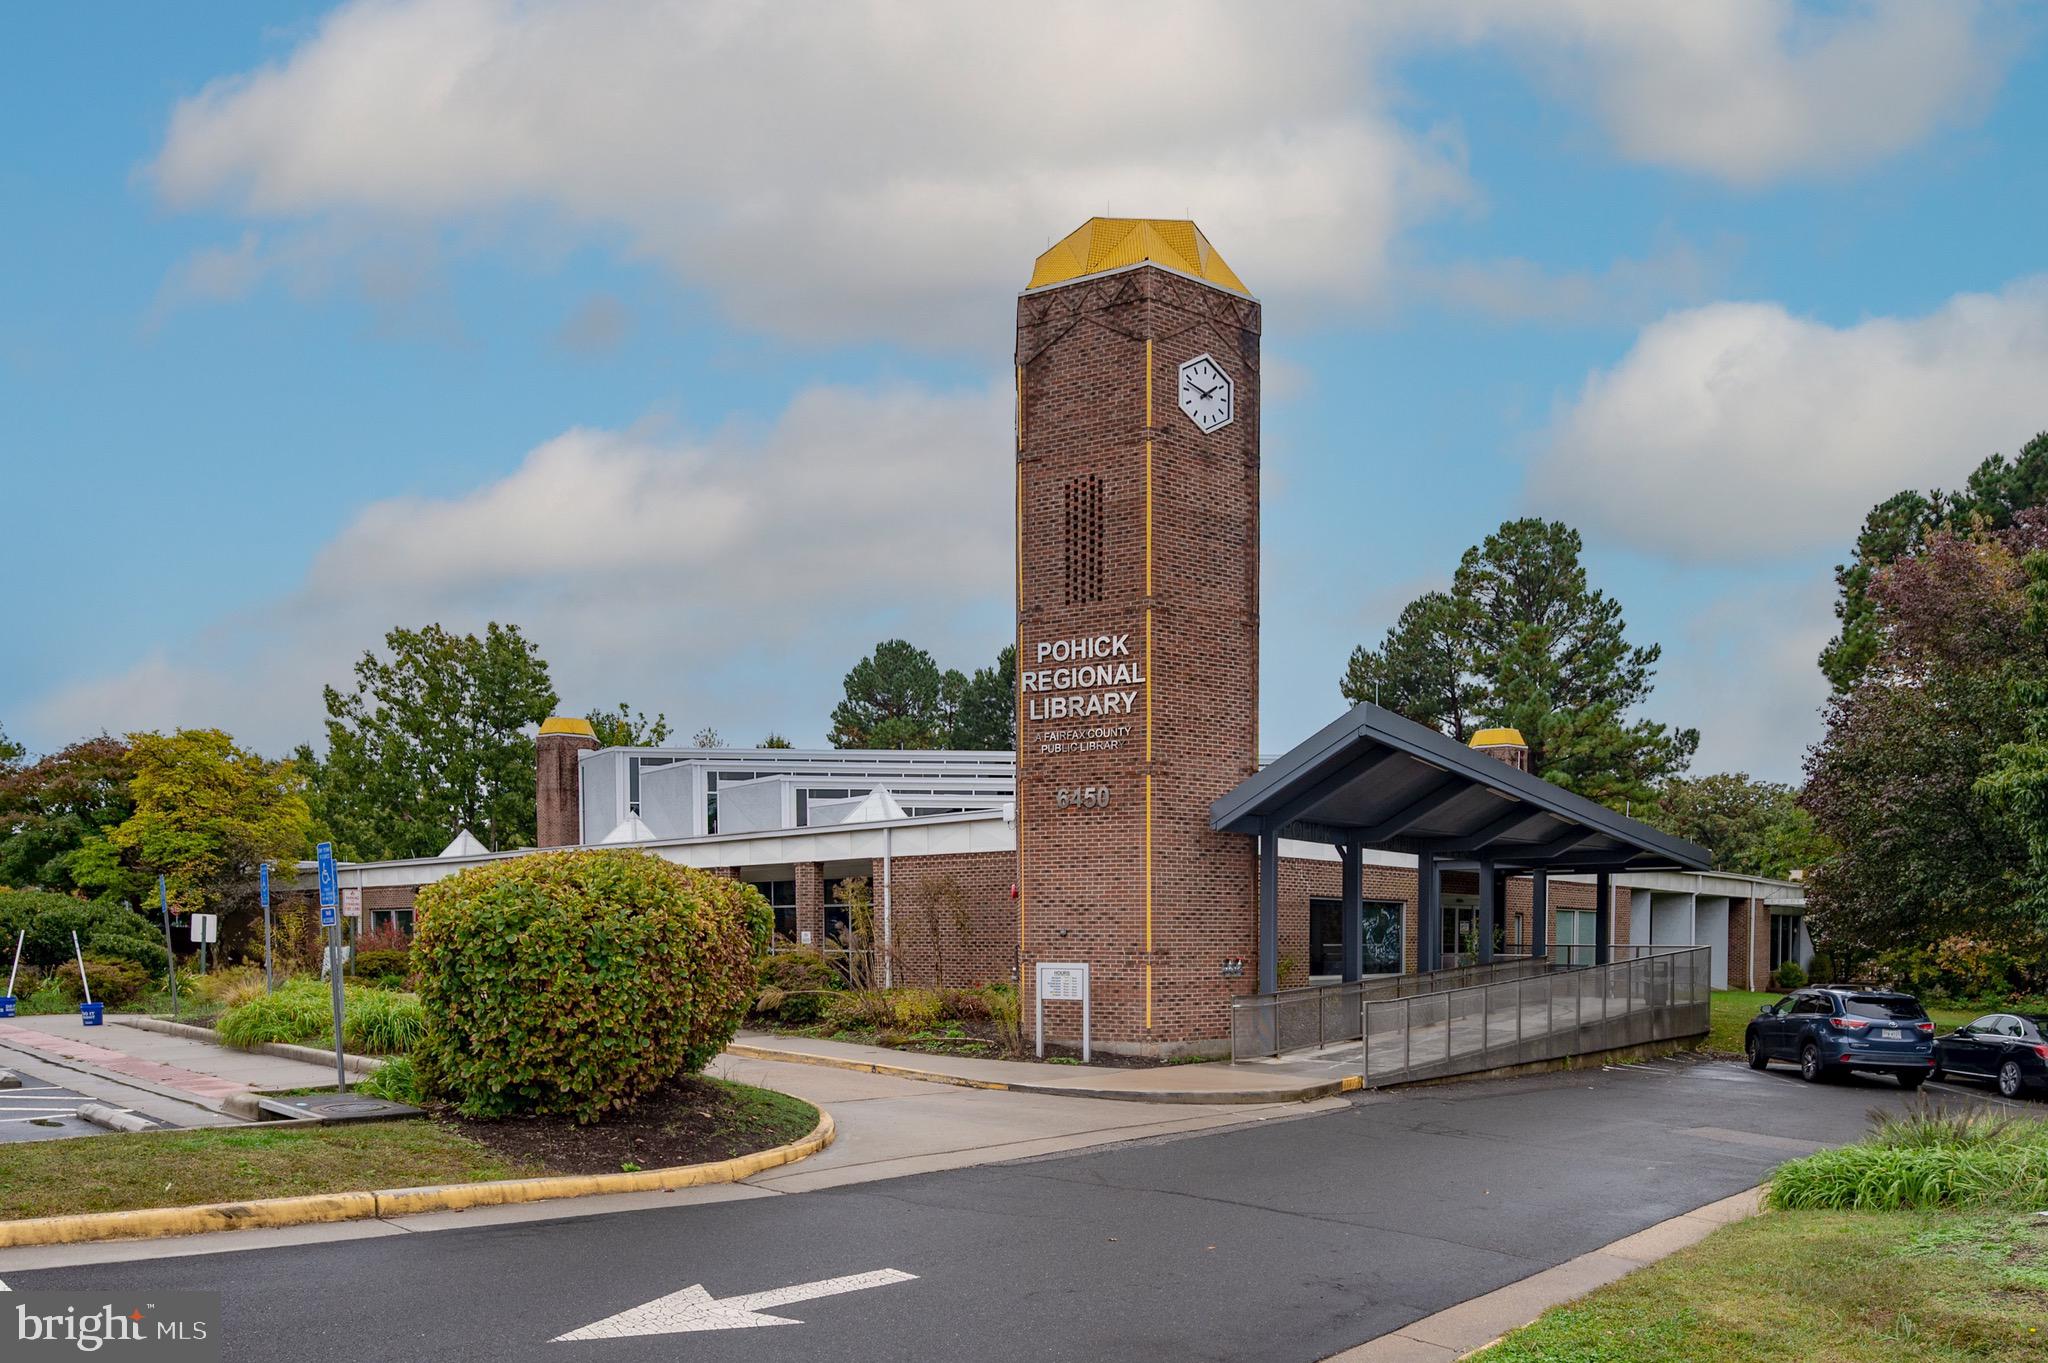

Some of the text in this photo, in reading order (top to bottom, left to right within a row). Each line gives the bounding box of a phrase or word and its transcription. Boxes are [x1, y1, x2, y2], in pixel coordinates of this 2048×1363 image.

[1037, 634, 1130, 664] POHICK
[1021, 662, 1146, 692] REGIONAL
[1029, 691, 1138, 721] LIBRARY
[1035, 726, 1132, 742] A FAIRFAX COUNTY
[1041, 740, 1126, 754] PUBLIC LIBRARY
[1056, 786, 1111, 809] 6450
